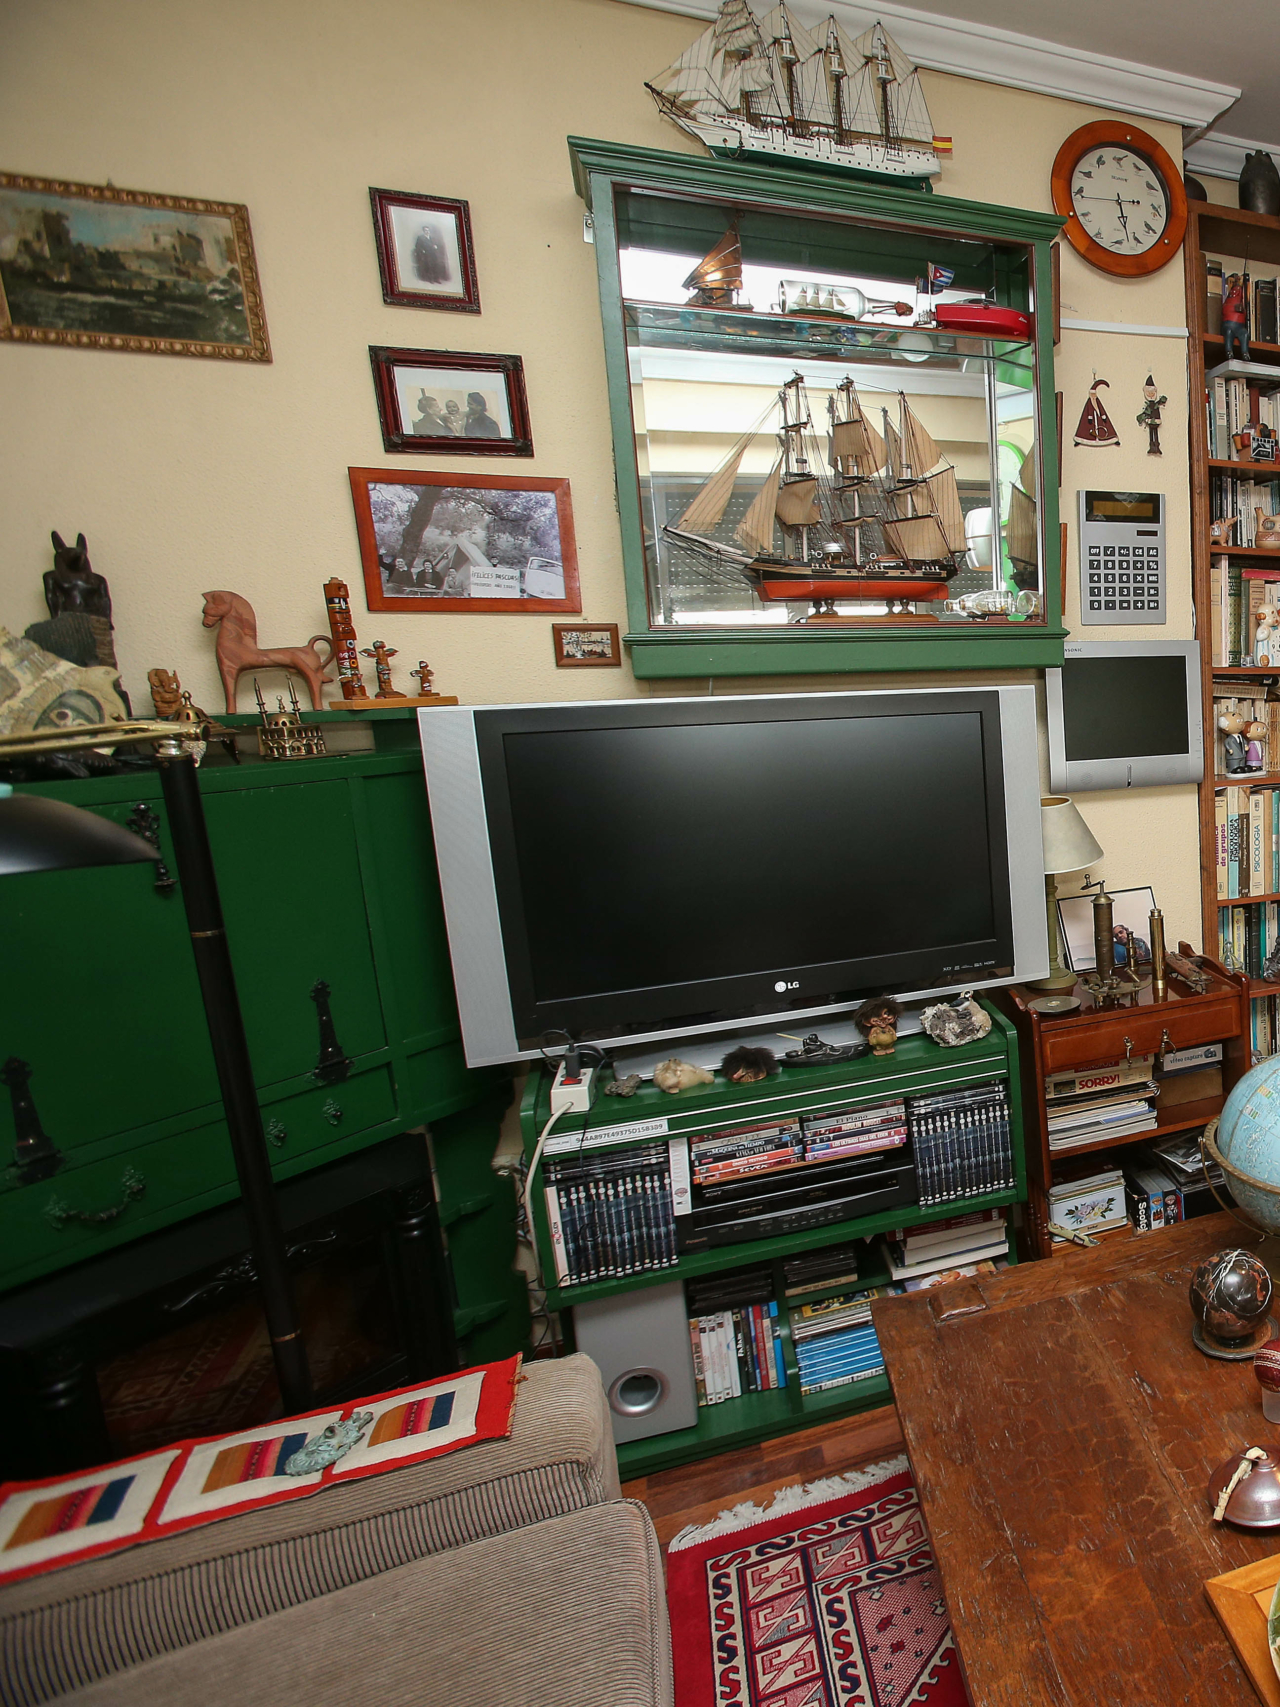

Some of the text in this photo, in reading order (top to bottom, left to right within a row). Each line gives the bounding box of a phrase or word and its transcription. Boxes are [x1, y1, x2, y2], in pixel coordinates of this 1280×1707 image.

[1220, 823, 1228, 867] de grupos
[787, 981, 800, 989] LG
[1169, 1053, 1203, 1064] video capture
[1078, 1073, 1120, 1090] SORRY!
[846, 1115, 868, 1123] Piano
[744, 1140, 765, 1148] TIEMPO
